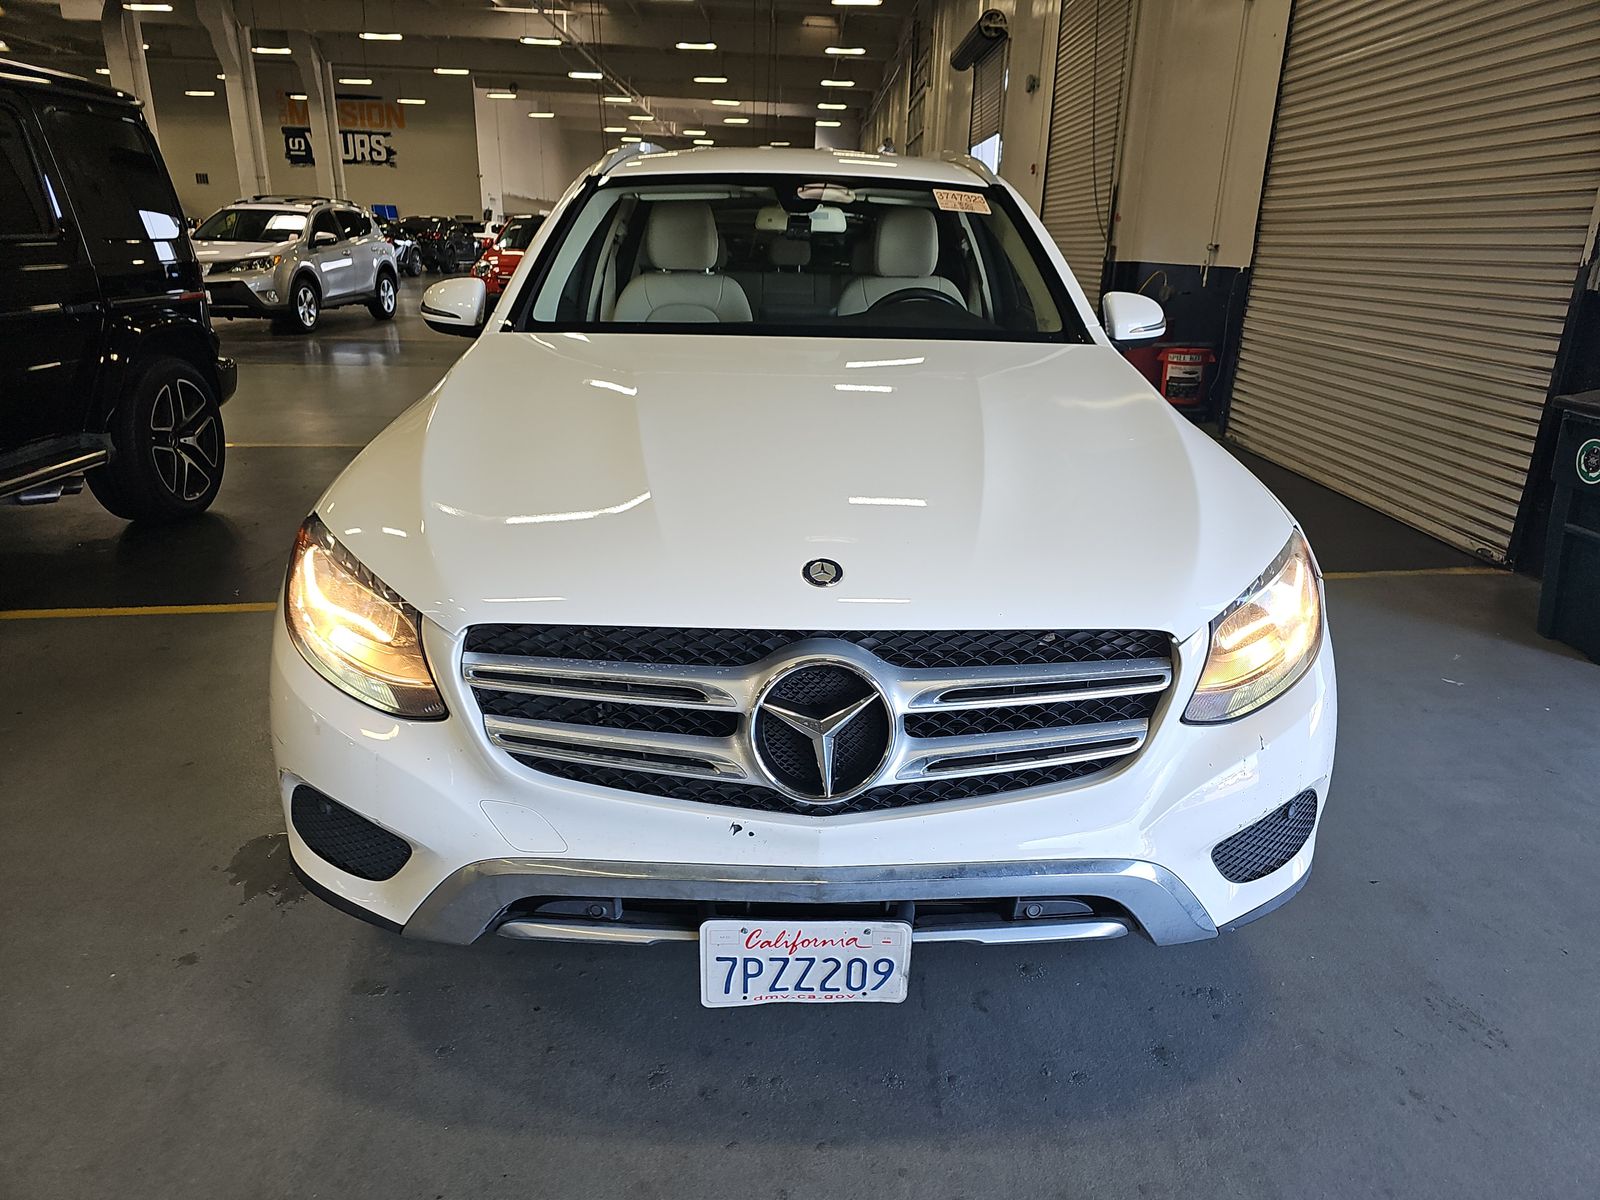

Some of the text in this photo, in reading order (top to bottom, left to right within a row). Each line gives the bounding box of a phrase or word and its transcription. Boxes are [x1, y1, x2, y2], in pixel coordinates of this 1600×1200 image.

[287, 99, 406, 129] MSION
[305, 131, 388, 162] URS
[745, 928, 873, 955] California
[716, 956, 895, 994] 7PZZ209
